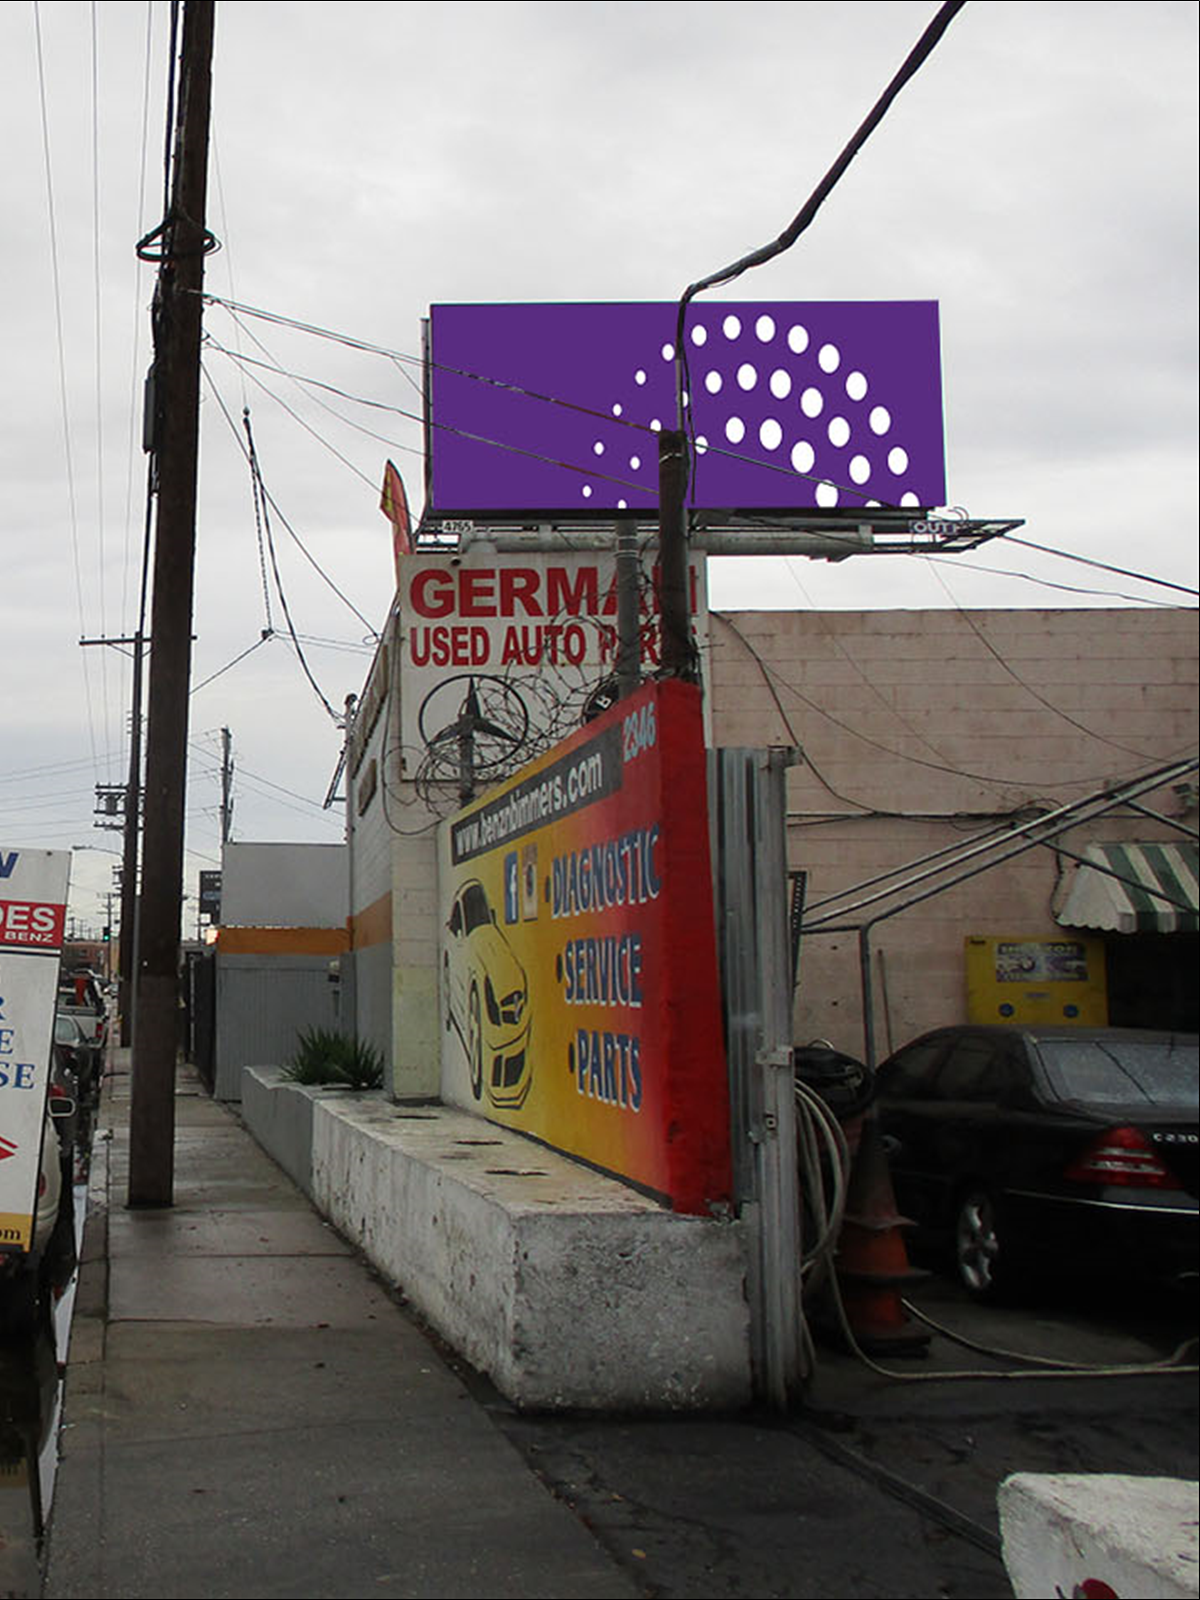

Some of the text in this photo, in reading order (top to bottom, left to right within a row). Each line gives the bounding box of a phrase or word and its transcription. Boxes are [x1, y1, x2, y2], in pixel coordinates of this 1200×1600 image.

[410, 626, 490, 667] USED
[501, 625, 586, 667] AUTO
[623, 701, 656, 762] 2346
[551, 826, 660, 919] DIAGNOSTIC
[4, 931, 54, 943] BENZ
[564, 933, 642, 1008] SERVICE
[575, 1028, 643, 1113] PARTS
